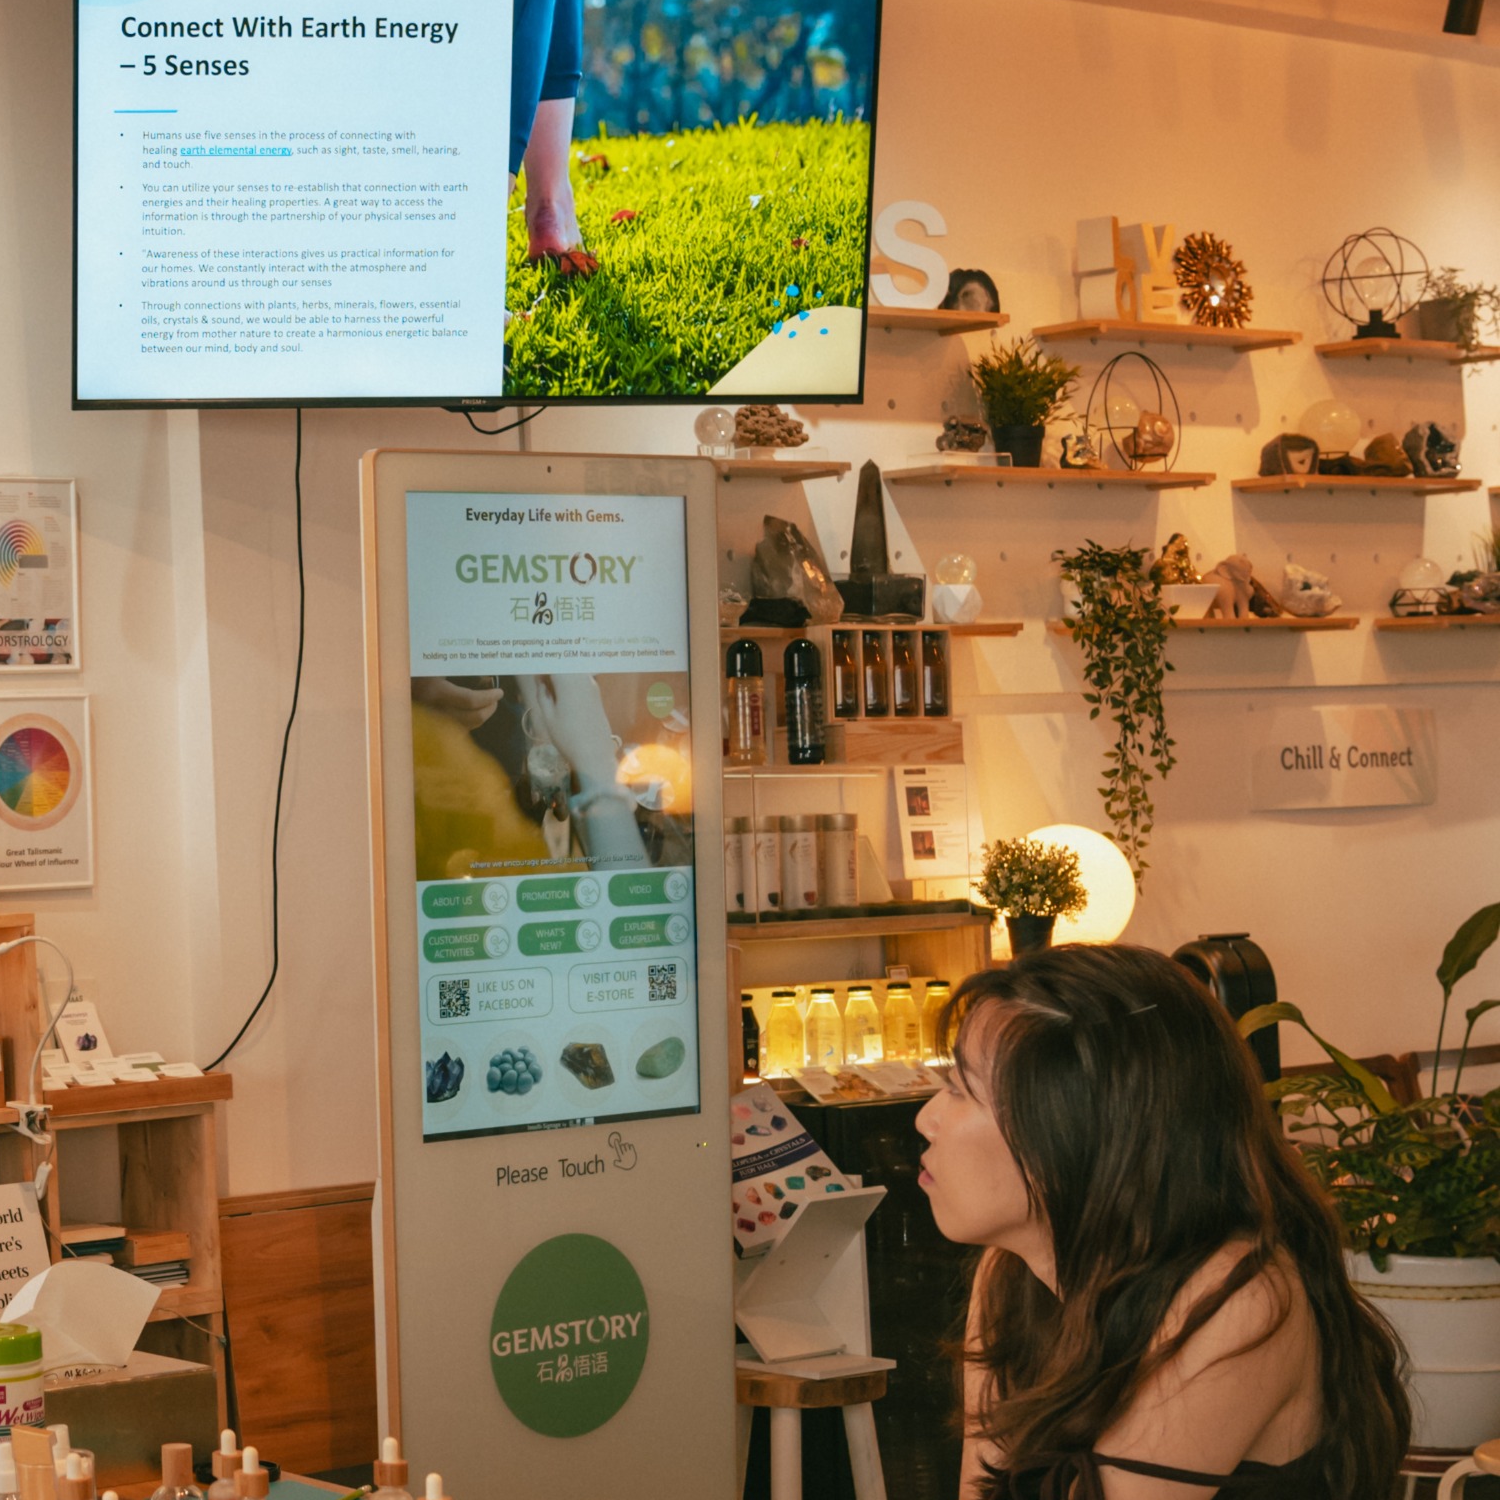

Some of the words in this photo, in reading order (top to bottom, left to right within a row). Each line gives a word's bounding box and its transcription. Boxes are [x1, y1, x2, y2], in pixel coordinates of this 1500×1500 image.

[121, 16, 224, 38] Connect
[232, 15, 293, 38] With
[302, 17, 366, 38] Earth
[375, 17, 459, 44] Energy
[143, 55, 157, 75] 5
[165, 54, 250, 76] Senses
[142, 131, 182, 140] Humans
[204, 130, 222, 139] five
[258, 131, 268, 139] in
[269, 130, 287, 140] the
[288, 132, 325, 141] process
[327, 130, 338, 140] of
[339, 131, 392, 141] connecting
[394, 130, 416, 140] with
[142, 145, 178, 156] healing
[179, 145, 207, 157] earth
[208, 145, 257, 157] elemental
[259, 147, 295, 158] energy,
[296, 145, 319, 154] such
[334, 145, 359, 157] sight,
[362, 146, 389, 156] taste,
[391, 145, 419, 156] smell,
[422, 145, 460, 156] hearing,
[141, 160, 161, 169] and
[162, 160, 193, 169] touch.
[142, 183, 160, 192] You
[162, 184, 179, 192] can
[181, 183, 211, 192] utilize
[212, 185, 235, 194] your
[237, 184, 269, 192] senses
[271, 183, 282, 192] to
[283, 182, 340, 192] re-establish
[341, 183, 362, 192] that
[363, 183, 417, 192] connection
[419, 183, 441, 192] with
[443, 182, 468, 192] earth
[870, 200, 949, 309] S
[466, 508, 525, 525] Everyday
[528, 508, 551, 522] Life
[554, 509, 583, 522] with
[586, 509, 624, 523] Gems.
[455, 552, 636, 585] GEMSTORY
[1281, 745, 1324, 771] Chill
[1329, 746, 1341, 771] &
[1347, 745, 1413, 769] Connect
[6, 849, 25, 857] Great
[27, 847, 63, 856] Talismanic
[14, 859, 37, 868] Wheel
[38, 858, 47, 866] of
[521, 890, 570, 902] PROMOTION
[628, 885, 652, 895] VIDEO
[433, 897, 460, 908] ABOUT
[462, 895, 473, 905] US
[535, 927, 565, 939] WHAT'S
[623, 921, 656, 932] EXPLORE
[428, 933, 480, 946] CUSTOMISED
[539, 940, 562, 952] NEW?
[619, 933, 660, 946] GEMSPEDIA
[434, 947, 475, 959] ACTIVITIES
[583, 972, 611, 985] VISIT
[613, 971, 637, 983] OUR
[477, 980, 498, 993] LIKE
[502, 980, 515, 991] US
[517, 978, 535, 990] ON
[587, 988, 635, 1003] E-STORE
[479, 997, 535, 1012] FACEBOOK
[496, 1165, 548, 1187] Please
[558, 1154, 605, 1178] Touch
[492, 1311, 642, 1357] GEMSTORY
